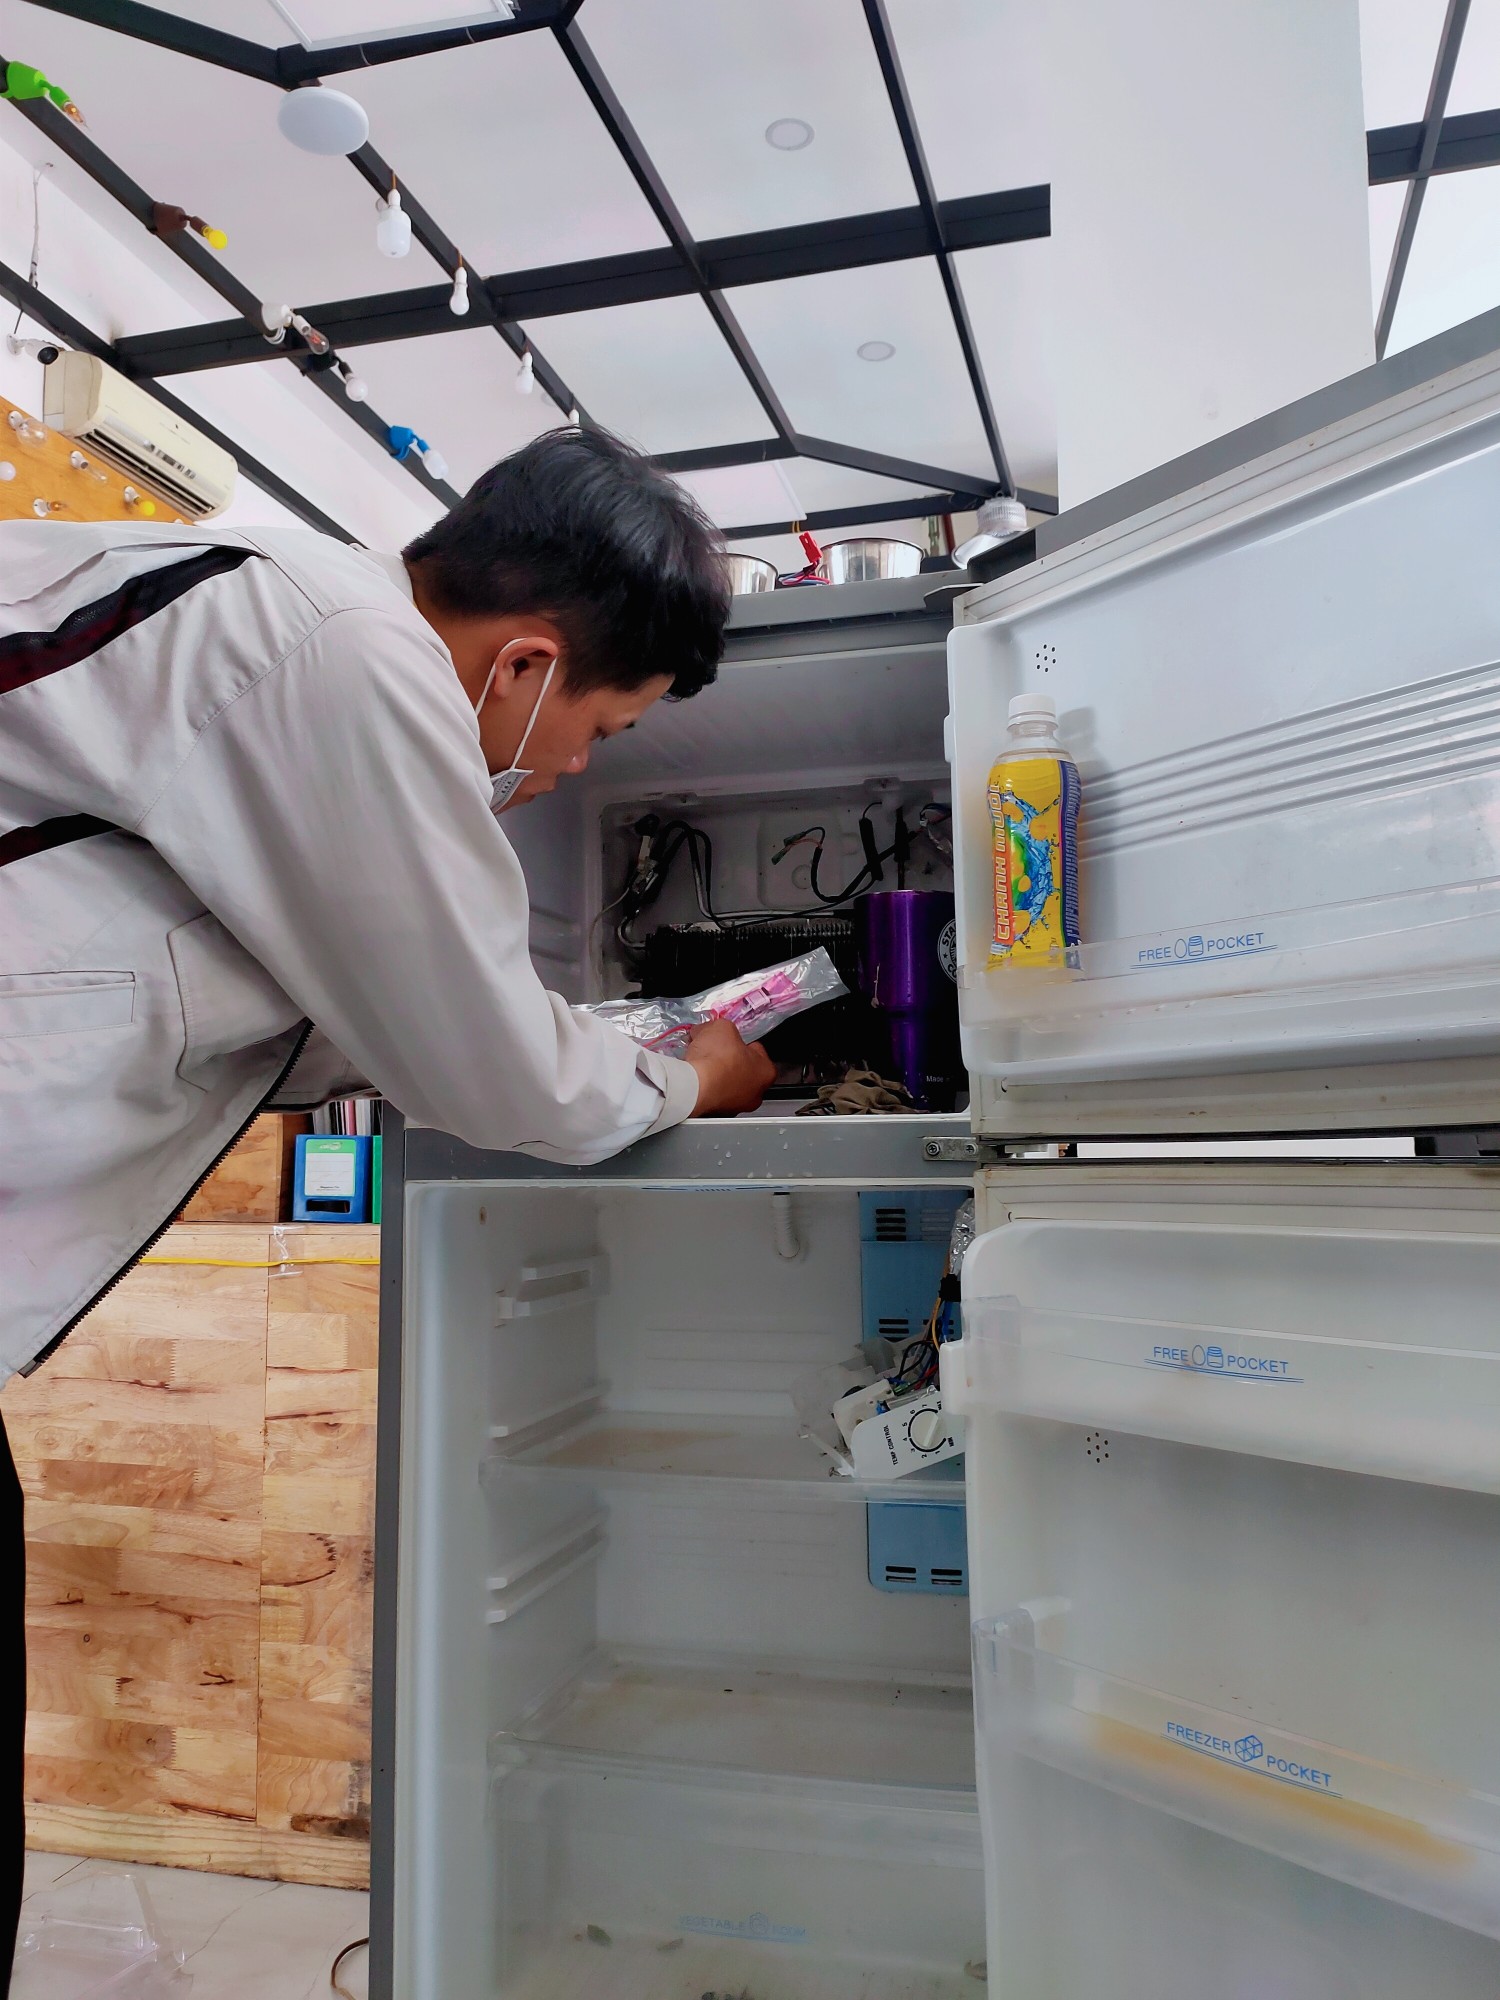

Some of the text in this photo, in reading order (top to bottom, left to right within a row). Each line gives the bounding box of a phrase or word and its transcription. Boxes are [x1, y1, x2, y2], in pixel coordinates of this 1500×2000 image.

[995, 856, 1010, 940] CHANH
[1138, 932, 1264, 962] FREE POCKET
[1153, 1346, 1288, 1373] FREE POCKET
[884, 1425, 898, 1465] TEMP CONTROL
[1167, 1721, 1331, 1787] FREEZER POCKET
[679, 1914, 746, 1931] VEGETABLE
